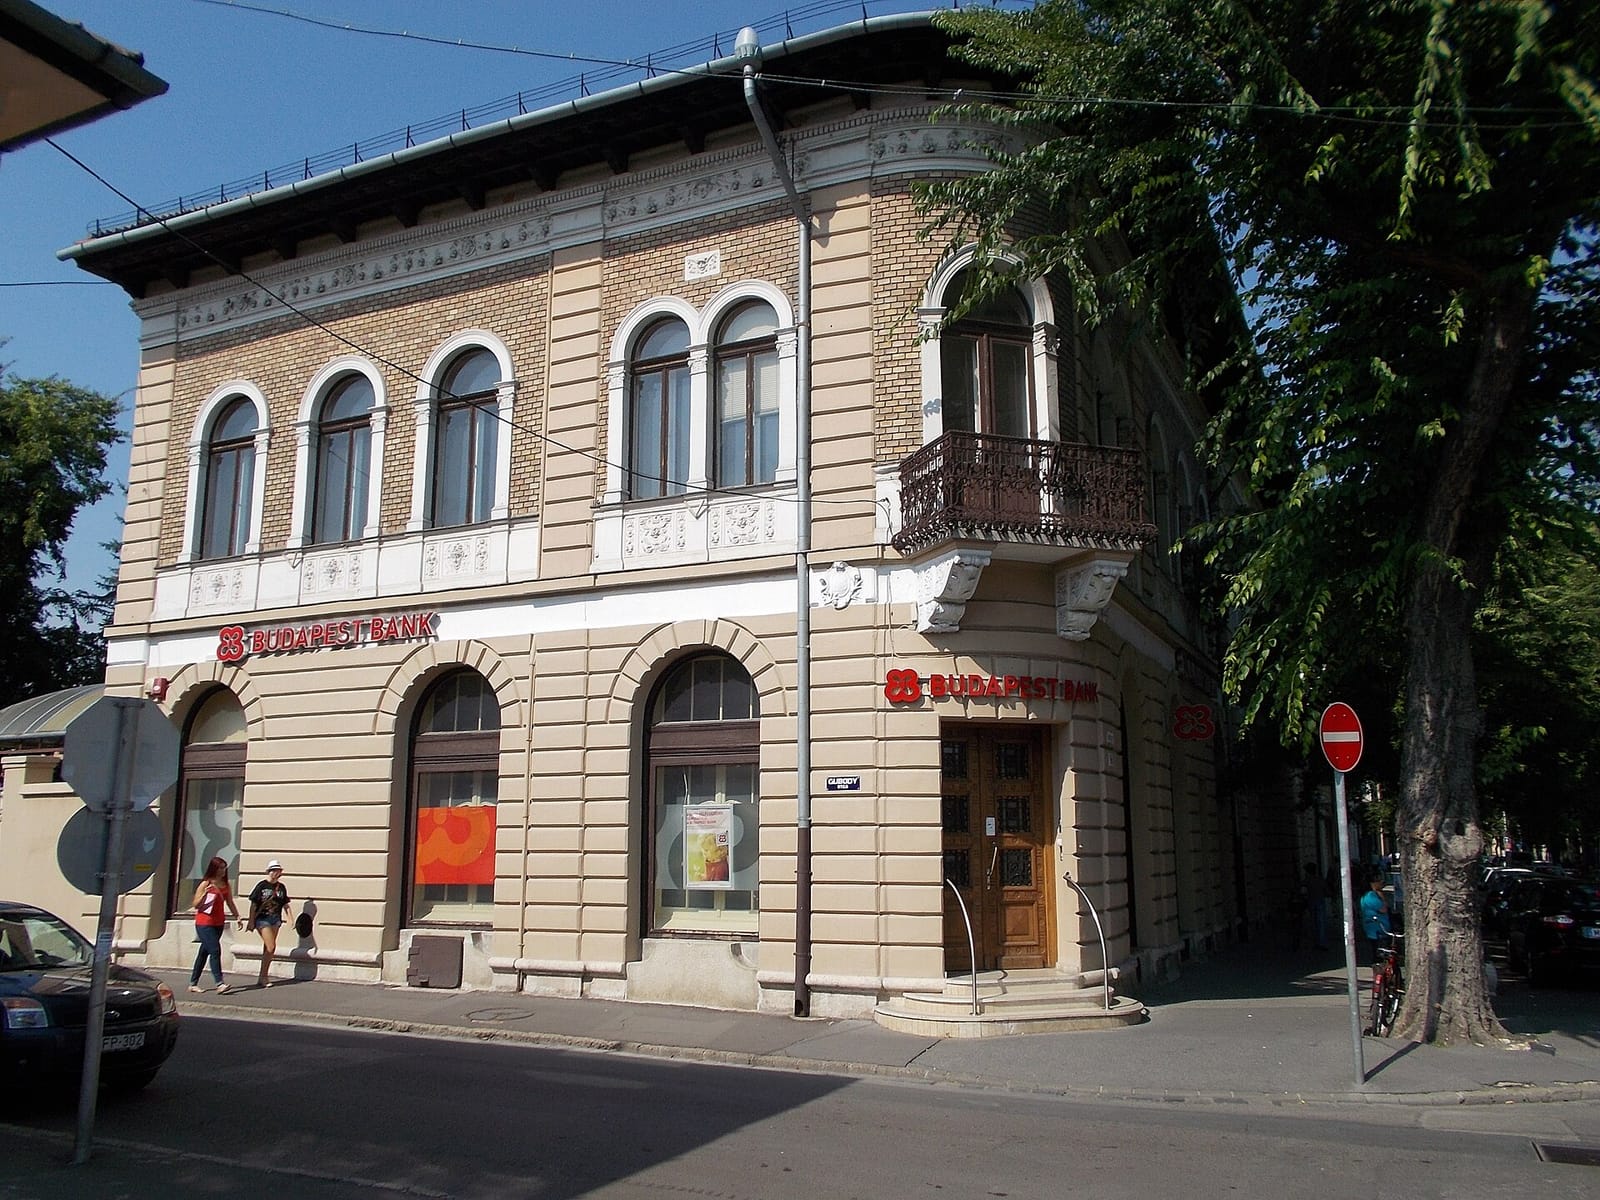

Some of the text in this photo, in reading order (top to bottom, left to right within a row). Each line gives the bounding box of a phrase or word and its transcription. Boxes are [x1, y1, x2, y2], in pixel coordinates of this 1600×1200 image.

[252, 612, 435, 652] BUDAPEST BANK
[930, 674, 1098, 702] BUDAPEST BANK
[102, 1033, 143, 1048] FP-302
